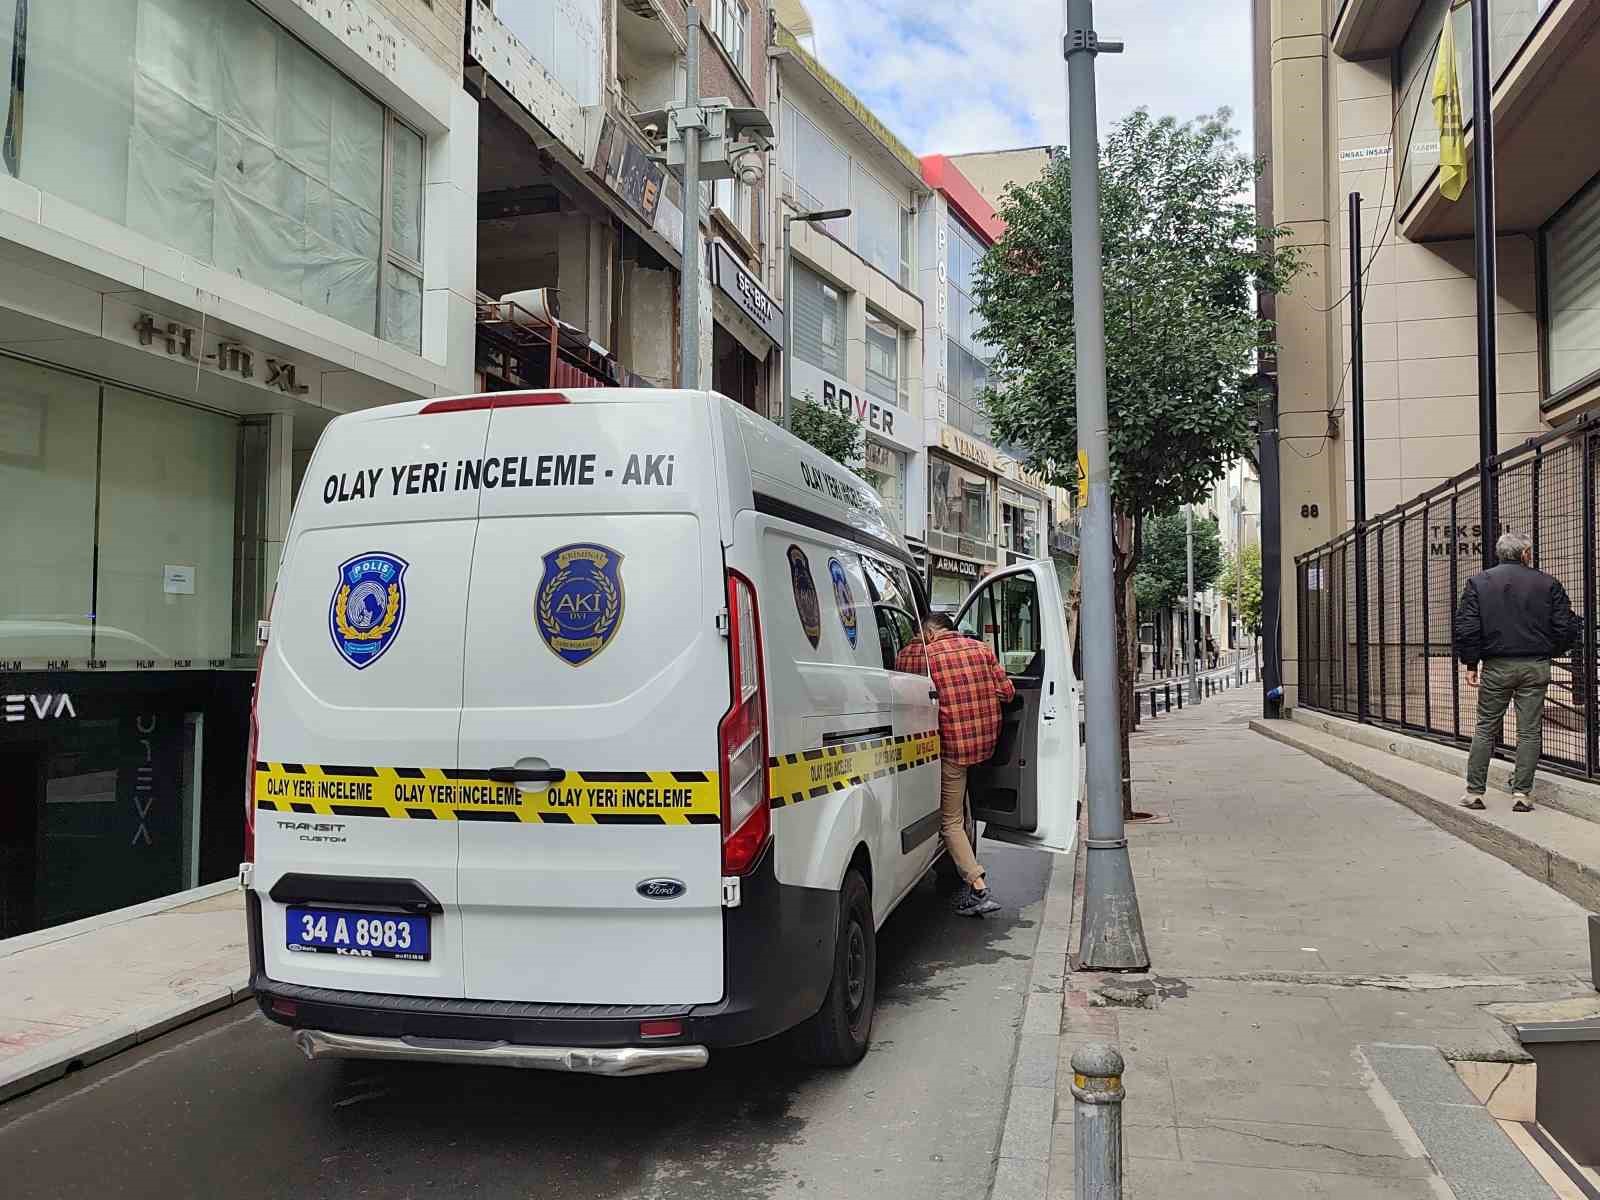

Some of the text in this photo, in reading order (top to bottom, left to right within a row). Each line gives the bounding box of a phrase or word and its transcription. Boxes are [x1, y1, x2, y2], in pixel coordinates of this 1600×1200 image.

[823, 379, 894, 436] ROVER
[323, 468, 384, 504] OLAY
[1300, 504, 1319, 518] 88
[936, 557, 958, 572] ARMA
[47, 660, 69, 670] HLM
[87, 659, 107, 669] HLM
[136, 659, 155, 669] HLM
[174, 659, 191, 668] HLM
[209, 659, 225, 668] HLM
[267, 778, 290, 796] OLAY
[394, 784, 426, 803] OLAY
[547, 787, 583, 807] OLAY
[277, 821, 347, 832] TRANSIT
[300, 835, 347, 843] CUSTOM
[647, 882, 676, 896] Ford
[302, 915, 411, 949] 34 A 8983
